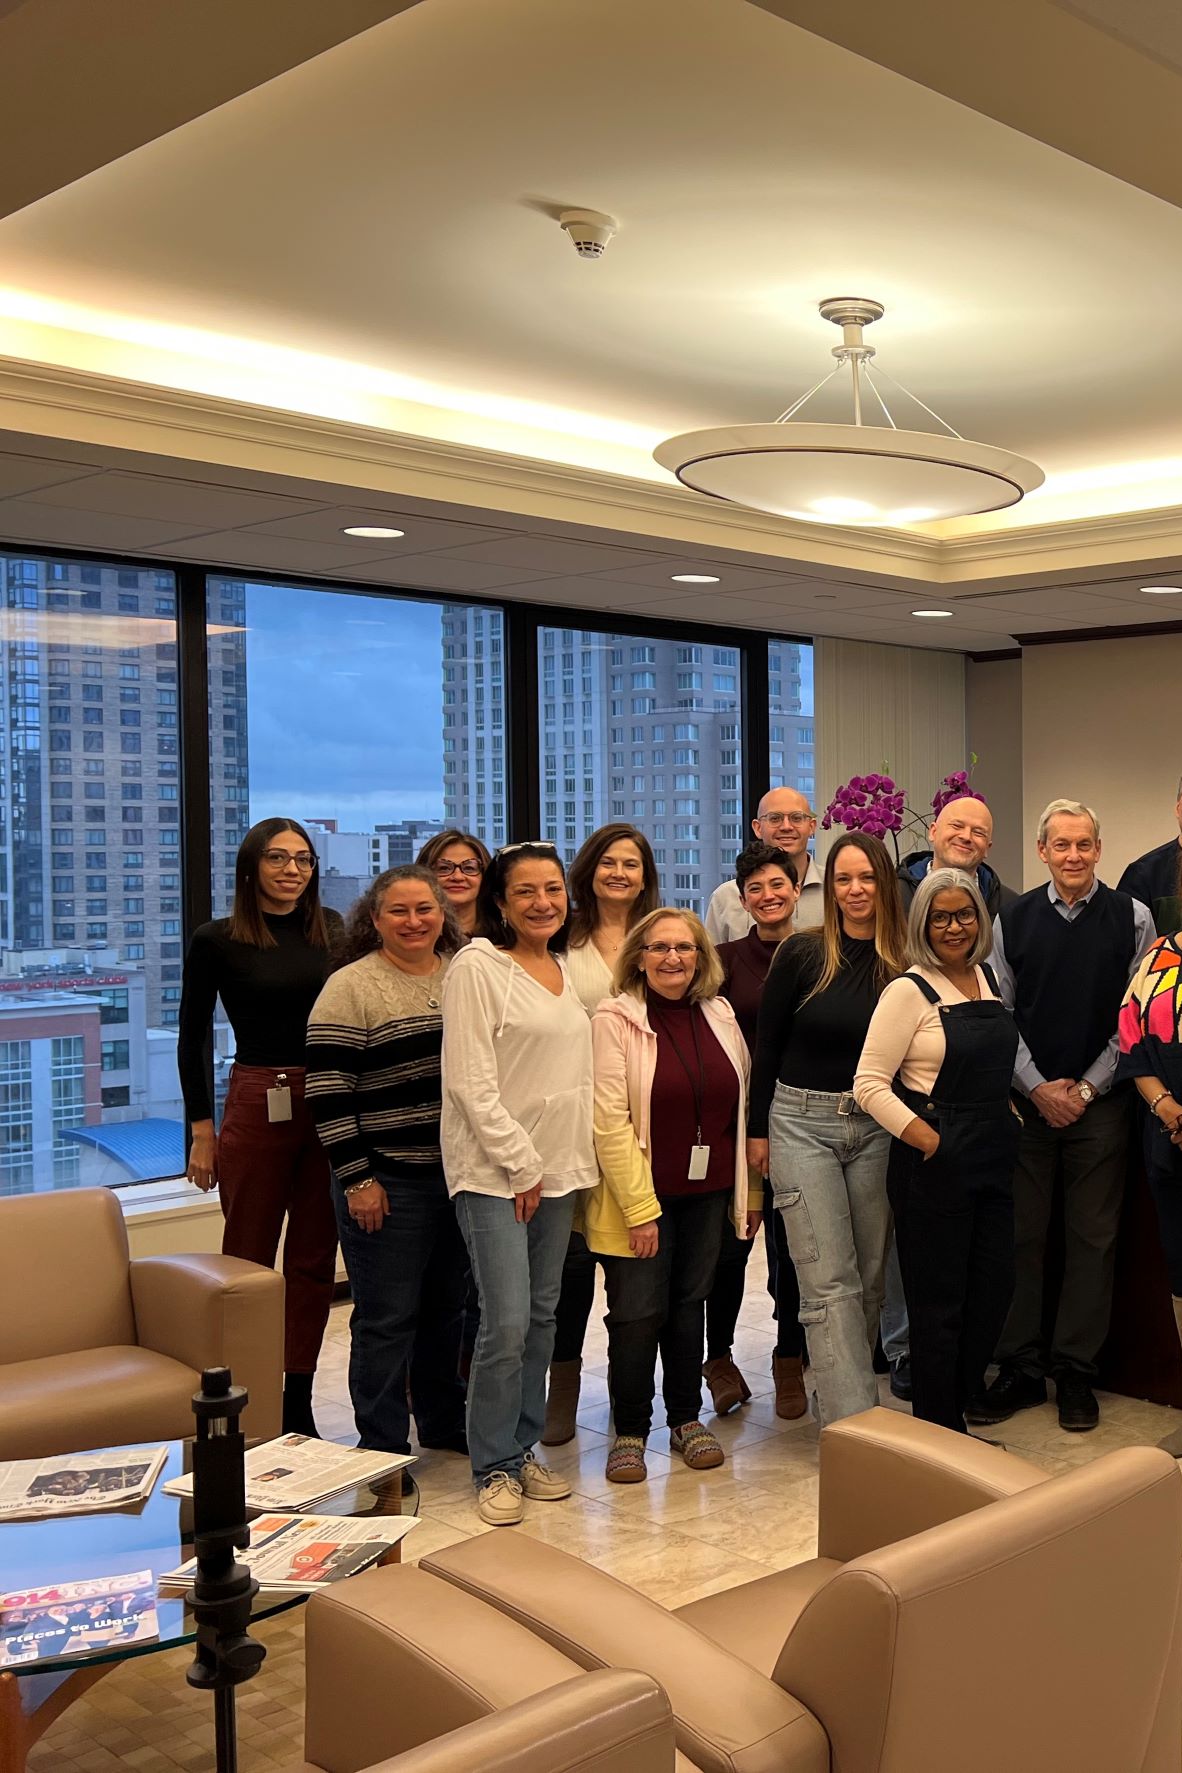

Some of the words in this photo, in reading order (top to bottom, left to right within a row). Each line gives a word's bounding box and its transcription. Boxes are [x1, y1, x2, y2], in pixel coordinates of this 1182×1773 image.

[5, 1627, 66, 1646] Places
[70, 1624, 89, 1632] to
[94, 1614, 144, 1629] Work
